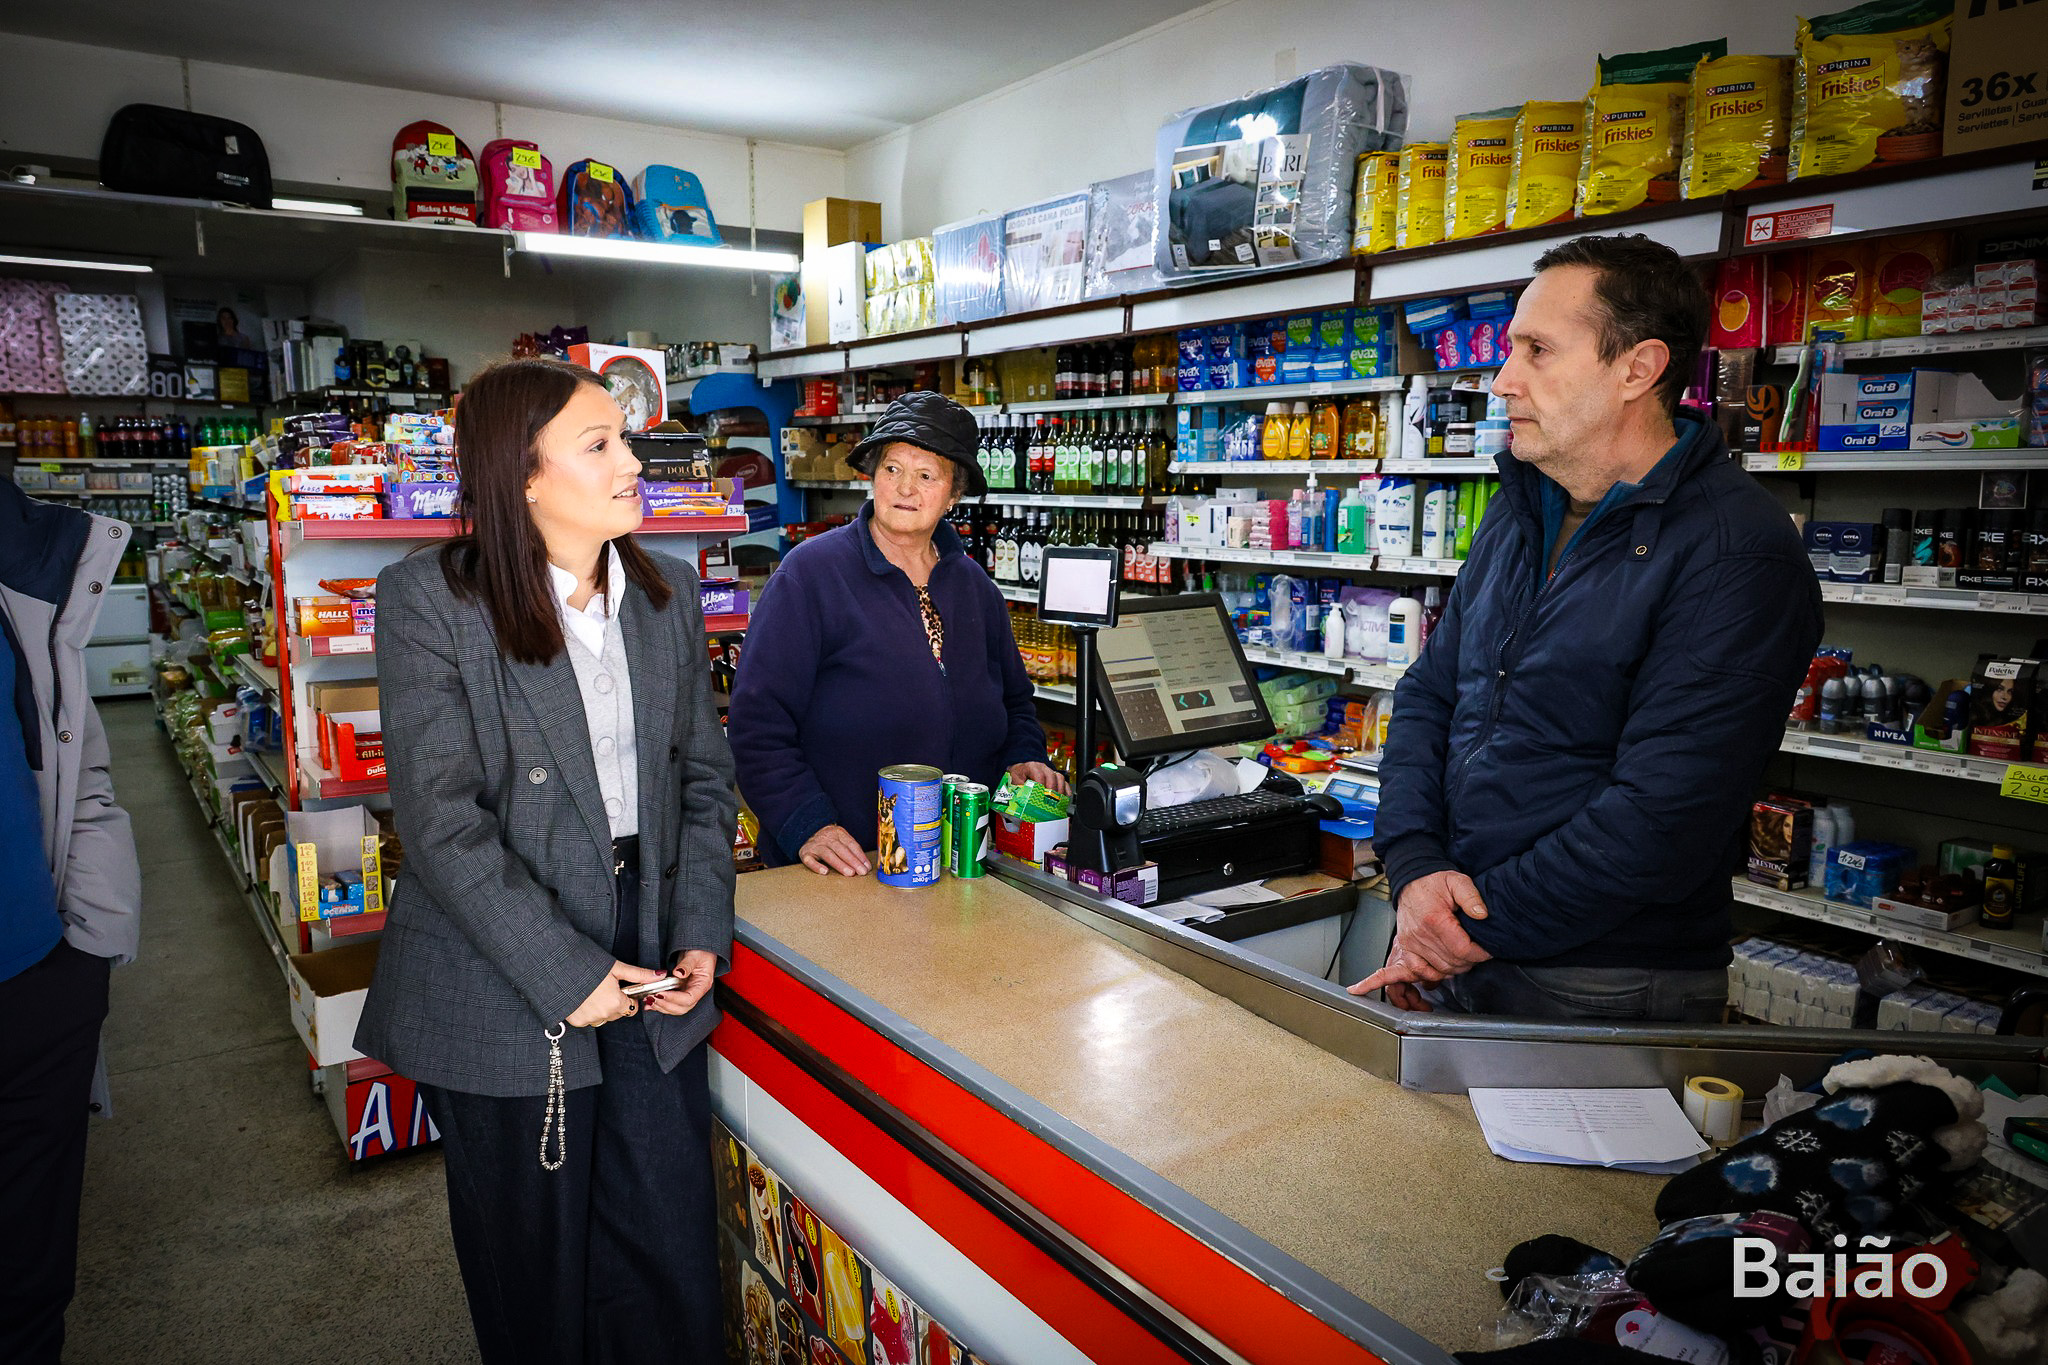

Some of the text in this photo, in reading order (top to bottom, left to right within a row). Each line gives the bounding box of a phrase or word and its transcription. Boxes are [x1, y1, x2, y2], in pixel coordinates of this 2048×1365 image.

[1829, 58, 1869, 71] PURINA
[1717, 82, 1754, 93] PURINA
[1821, 74, 1882, 99] Friskies
[1960, 72, 2038, 107] 36x
[1611, 111, 1645, 120] PURINA
[1709, 99, 1764, 120] Friskies
[1959, 105, 2012, 121] Servilletas
[1541, 124, 1573, 132] PURINA
[1957, 119, 2009, 134] Serviettes
[1604, 126, 1653, 144] Friskies
[1816, 134, 1836, 142] Adult
[1534, 139, 1580, 153] Friskies
[1469, 153, 1512, 167] Friskies
[417, 205, 441, 215] Mickey
[1008, 205, 1085, 229] JOGO DE CAMA POLAR
[1985, 237, 2048, 253] DENIM
[1288, 318, 1312, 329] evax
[1321, 319, 1344, 331] evax
[1354, 316, 1378, 328] evax
[1211, 336, 1231, 344] evax
[1249, 336, 1270, 346] evax
[1272, 331, 1286, 341] eva
[1180, 338, 1203, 349] evax
[1446, 331, 1458, 365] evax
[1483, 325, 1491, 360] evax
[1350, 348, 1378, 360] evax
[1256, 358, 1276, 368] evax
[1179, 366, 1200, 377] evax
[1211, 364, 1231, 375] evax
[1863, 382, 1899, 394] Oral-B
[1861, 407, 1897, 419] Oral-B
[1843, 434, 1879, 447] Oral-B
[411, 487, 458, 511] Milka
[1959, 575, 1982, 583] AXE
[318, 610, 349, 618] HALLS
[1989, 667, 2015, 675] Palette
[1874, 730, 1907, 742] NIVEA
[1974, 727, 2019, 739] INTENSIVE
[2015, 861, 2027, 909] LONG LIFE
